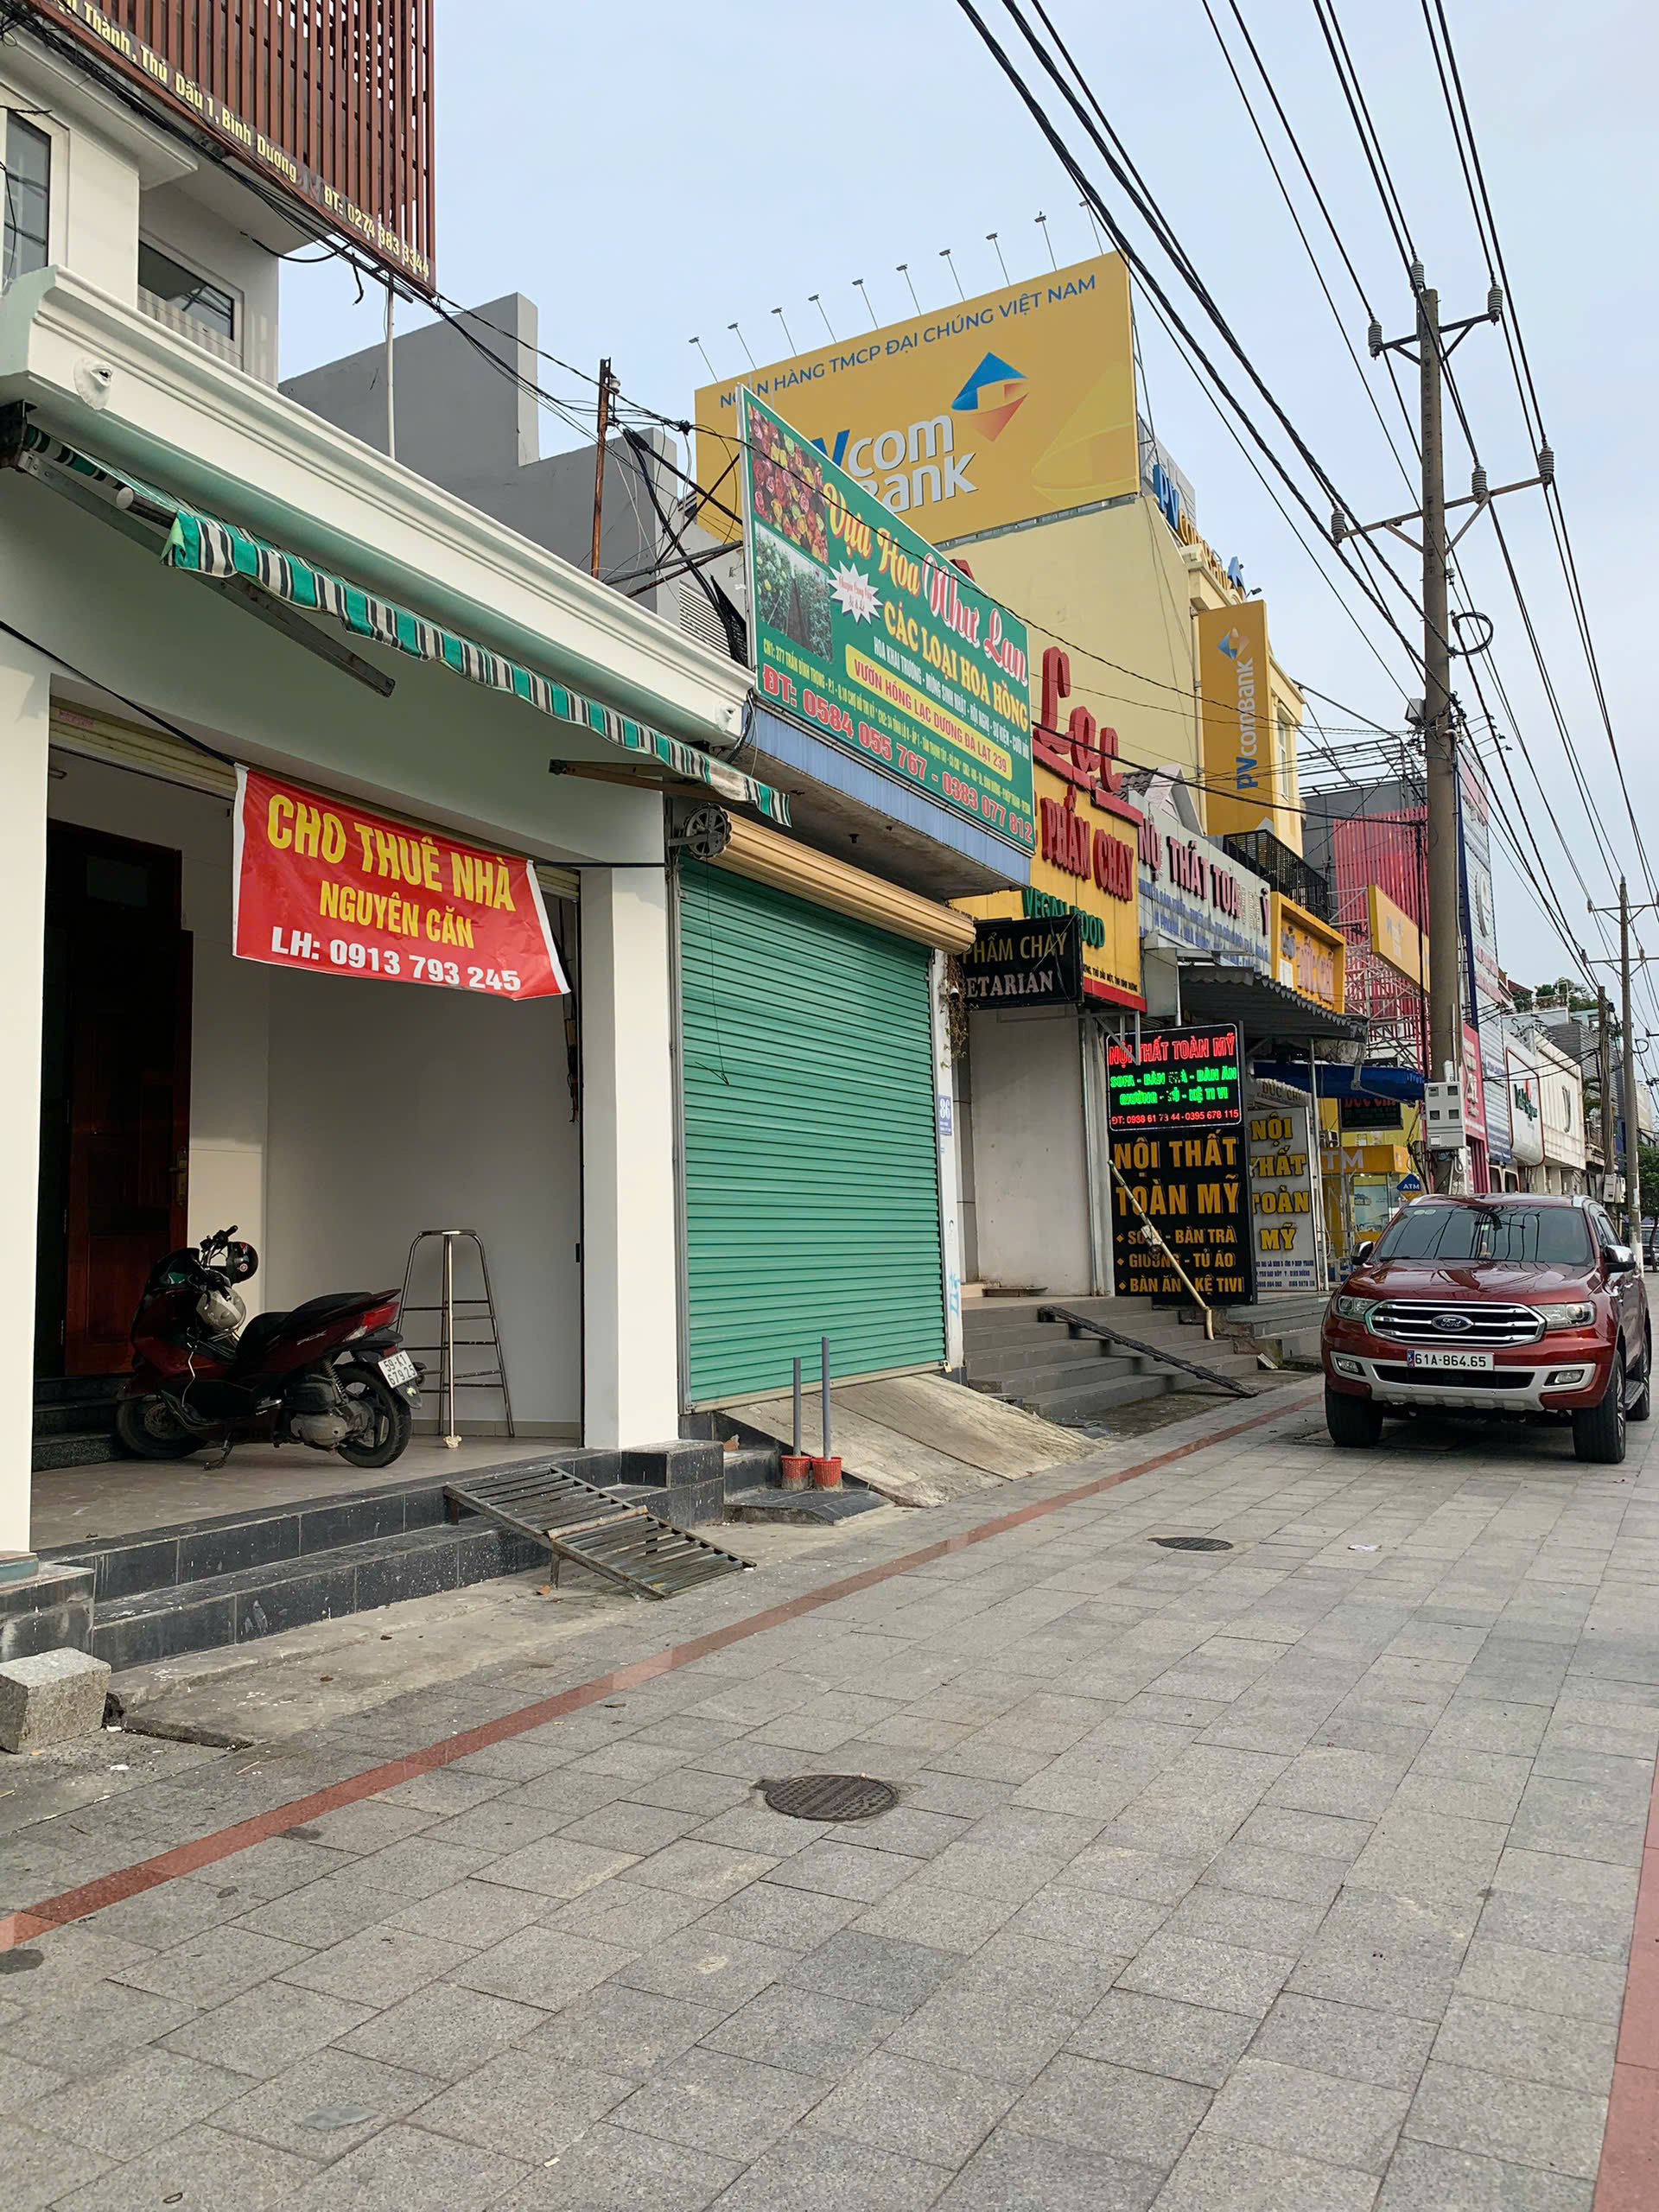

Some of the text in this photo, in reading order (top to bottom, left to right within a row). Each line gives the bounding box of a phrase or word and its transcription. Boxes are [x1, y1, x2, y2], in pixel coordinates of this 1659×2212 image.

[140, 44, 168, 84] Thủ
[175, 72, 203, 110] Dầu
[221, 106, 251, 147] Bình
[257, 134, 296, 183] Dương
[347, 202, 375, 238] 0274
[774, 363, 825, 391] HÀNG
[829, 345, 880, 373] TMCP
[885, 332, 918, 355] ĐẠI
[923, 308, 994, 343] CHÚNG
[999, 291, 1042, 317] VIỆT
[1047, 274, 1096, 303] NAM
[810, 415, 954, 478] Vcom
[876, 527, 920, 597] Hoa
[922, 552, 981, 648] Như
[983, 607, 1028, 688] Lan
[884, 601, 1029, 733] CÁC LOẠI HOA HỒNG
[854, 658, 882, 692] VƯỜN
[914, 698, 931, 722] LẠC
[934, 710, 963, 744] DƯƠNG
[977, 741, 991, 763] LẠT
[993, 752, 1007, 773] 239
[762, 663, 798, 708] ĐT:
[803, 688, 855, 740] 0584
[858, 721, 893, 761] 055
[896, 741, 927, 780] 767
[982, 794, 1007, 827] 077
[1009, 812, 1033, 843] 812
[266, 793, 517, 912] CHO THUÊ NHÀ
[1093, 829, 1134, 901] CHAY
[319, 880, 474, 949] NGUYÊN CĂN
[270, 925, 521, 991] LH: 0913 793 245
[1020, 932, 1068, 959] CHAY
[1172, 1035, 1210, 1060] TOÀN
[1212, 1033, 1236, 1057] MỸ
[1110, 1074, 1135, 1088] SOFA
[1143, 1071, 1166, 1086] BÀN
[939, 1098, 950, 1120] 86
[1206, 1110, 1222, 1119] 678
[1224, 1109, 1239, 1118] 115
[1250, 1111, 1294, 1147] NỘI
[1114, 1128, 1238, 1177] NỘI THẤT
[1320, 1149, 1364, 1171] TM
[1116, 1173, 1239, 1216] TOÀN MỸ
[1174, 1226, 1205, 1244] BÀN
[1207, 1224, 1236, 1243] TRÀ
[1260, 1222, 1297, 1251] MỸ
[1192, 1248, 1210, 1268] TỦ
[1214, 1249, 1236, 1268] ÁO
[1129, 1274, 1244, 1295] BÀN ĂN KỆ TIVI
[1440, 1317, 1462, 1328] Ford
[383, 1353, 407, 1372] 59-K1
[387, 1363, 416, 1385] 679.25
[1414, 1353, 1486, 1368] 61A-864.65
